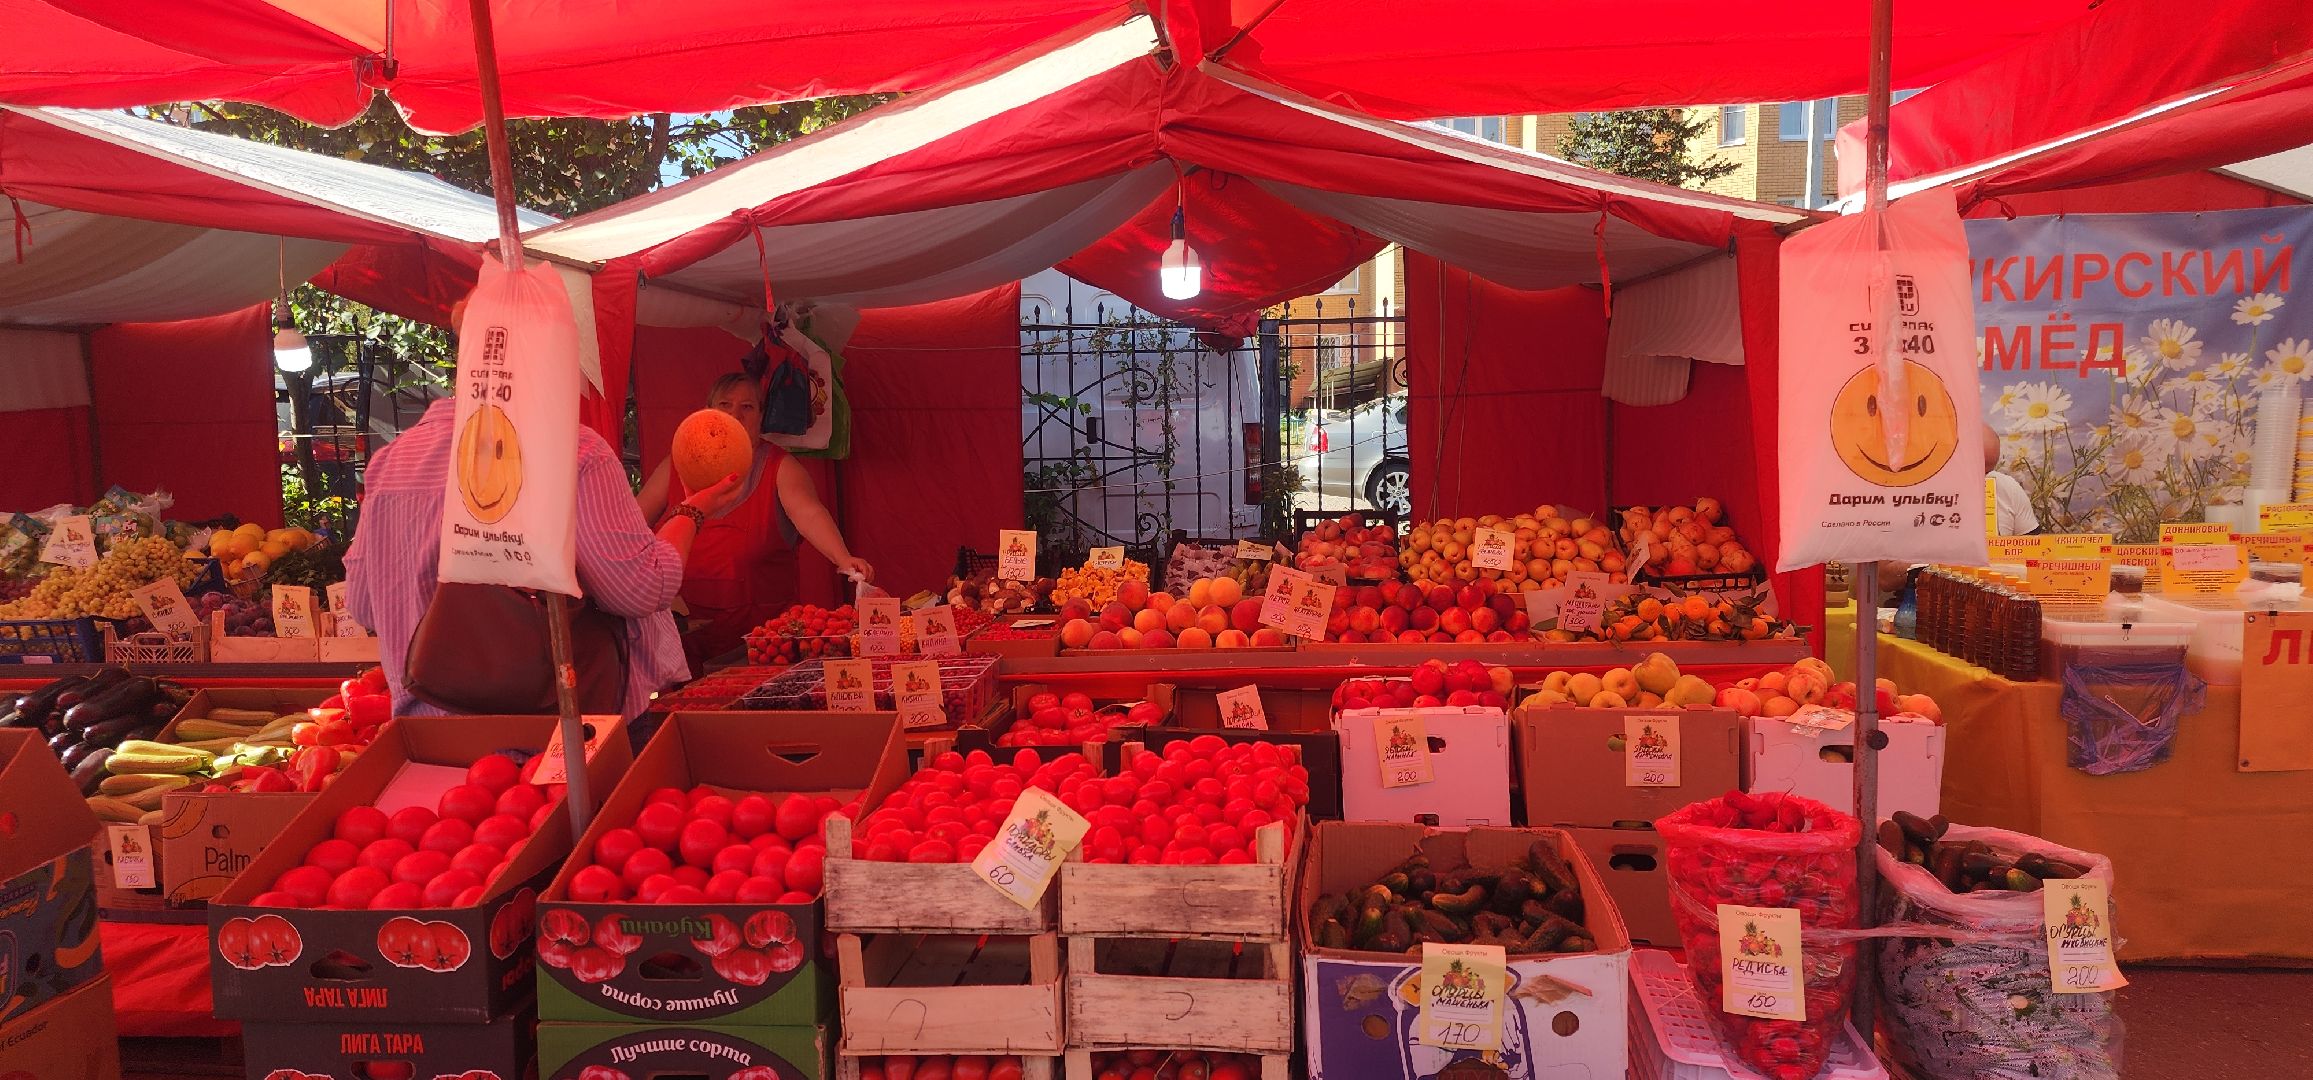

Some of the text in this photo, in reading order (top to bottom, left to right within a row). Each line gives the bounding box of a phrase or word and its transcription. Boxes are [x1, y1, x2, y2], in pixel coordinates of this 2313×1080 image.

[1969, 233, 2294, 302] КИРСКИЙ
[1983, 313, 2127, 378] МЁД
[1829, 492, 1960, 507] Дарим улыбку!
[454, 523, 524, 546] Дарим улыбку!
[2165, 525, 2228, 535] ДОННИКОВЫЙ
[1988, 538, 2041, 547] КЕДРОВЫЙ
[2037, 562, 2101, 571] ГРЕЧИШНЫЙ
[1397, 770, 1417, 781] 200
[1643, 772, 1665, 783] 200
[204, 846, 251, 873] Palm
[989, 865, 1015, 885] 60
[620, 916, 713, 941] Кубани
[2067, 965, 2099, 985] 200
[303, 987, 389, 1008] ЛИГА ТАРА
[601, 983, 739, 1011] Лучшие сорта
[1747, 994, 1776, 1008] 150
[8, 1020, 49, 1048] Ecuador
[340, 1033, 425, 1054] ЛИГА ТАРА
[1438, 1021, 1481, 1045] 170
[610, 1038, 751, 1067] Лучшие сорта
